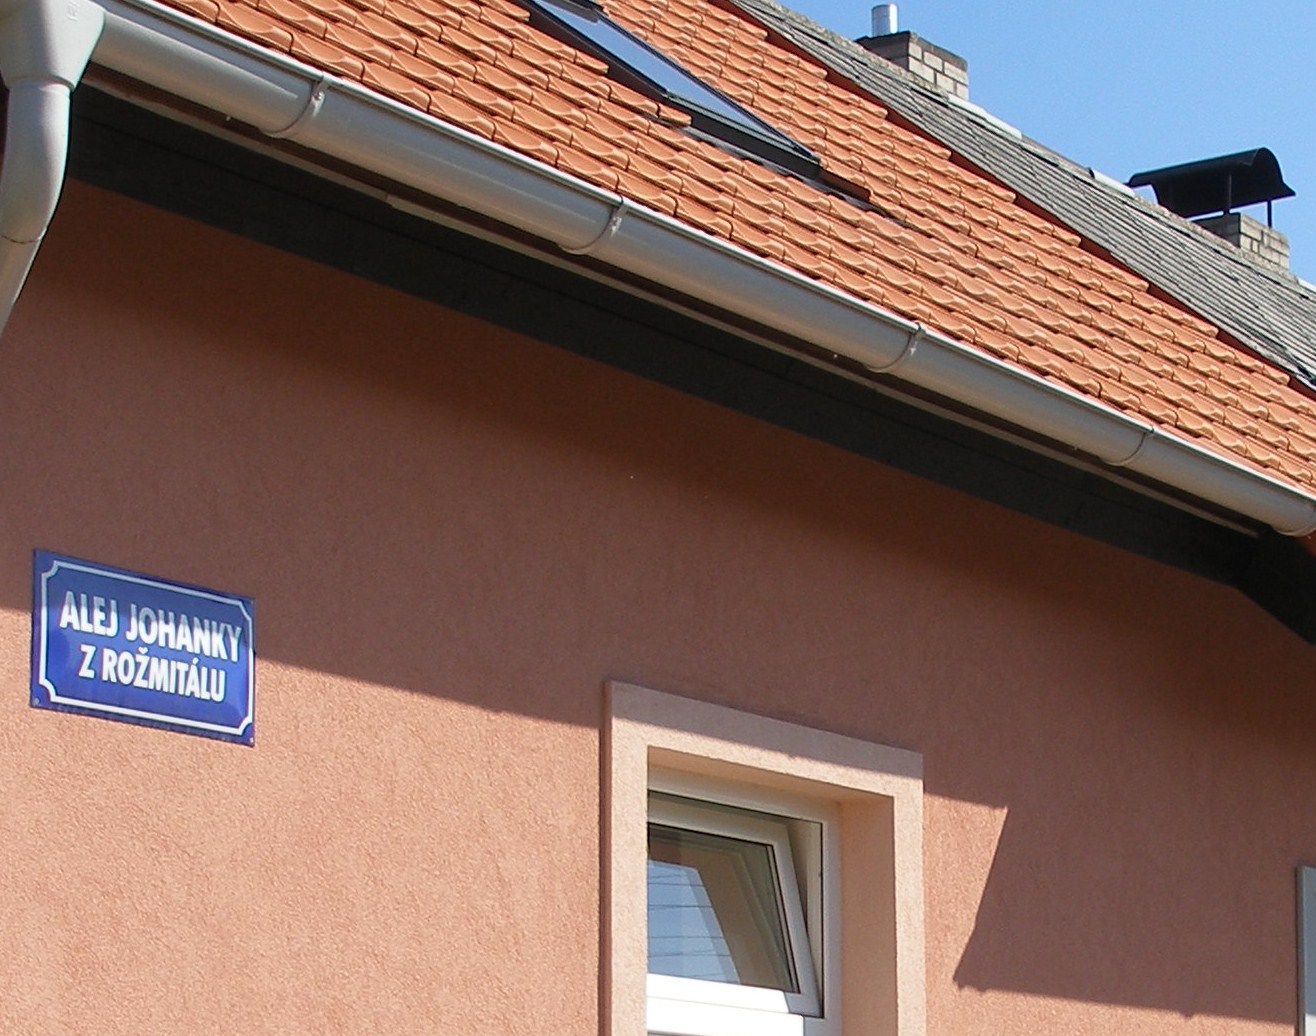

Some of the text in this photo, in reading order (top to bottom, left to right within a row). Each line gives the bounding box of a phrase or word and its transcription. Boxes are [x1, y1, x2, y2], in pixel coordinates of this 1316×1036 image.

[59, 590, 242, 662] ALEJ JOHANKY
[78, 643, 226, 703] Z ROŽMITÁLU
